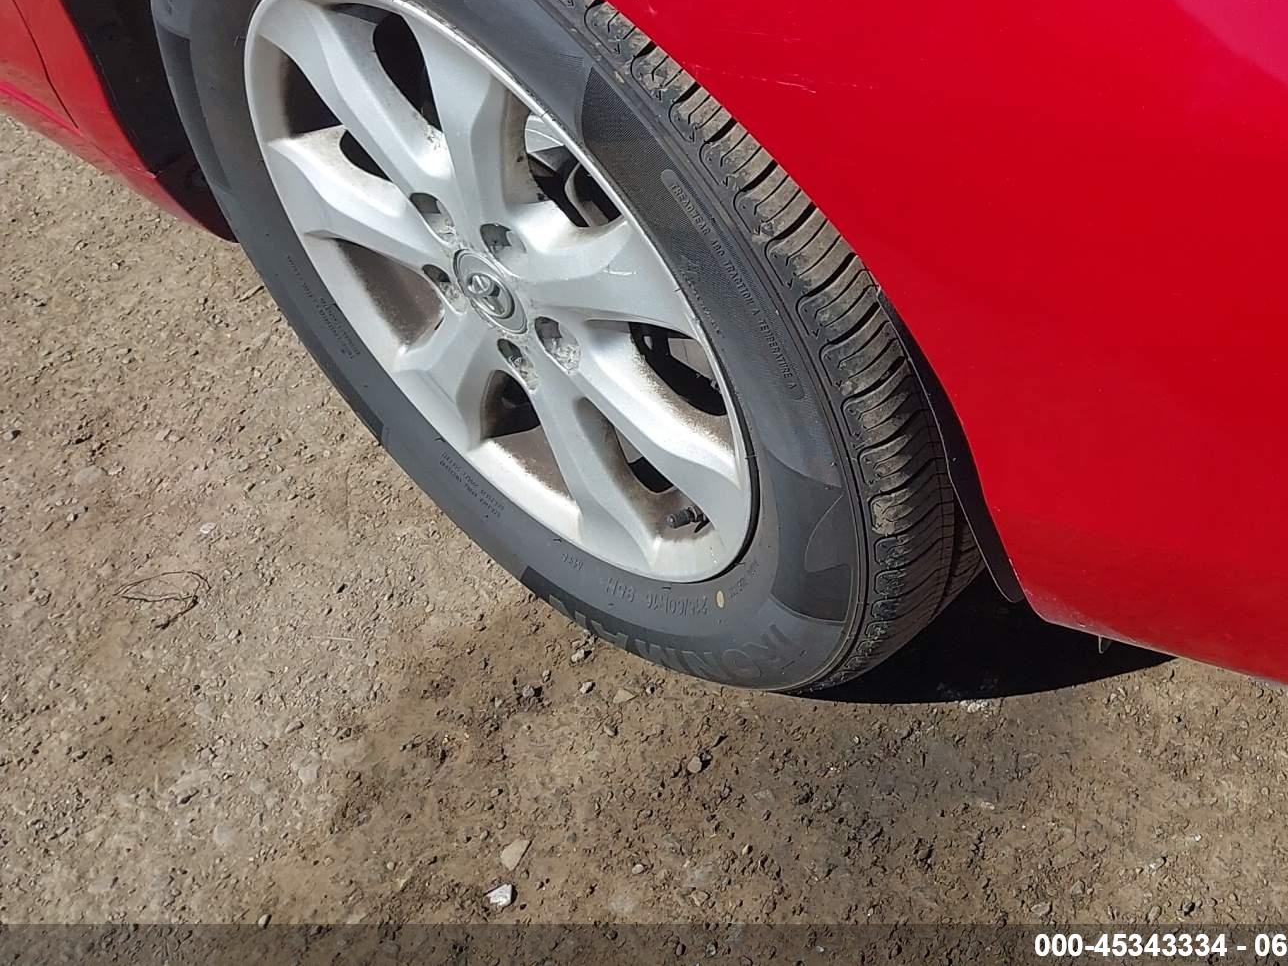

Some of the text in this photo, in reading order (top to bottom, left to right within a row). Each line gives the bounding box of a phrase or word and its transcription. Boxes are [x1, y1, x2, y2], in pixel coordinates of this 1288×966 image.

[669, 183, 711, 236] TREADWEAR
[723, 258, 754, 305] TRACTION
[757, 319, 794, 380] TEMPERATURE
